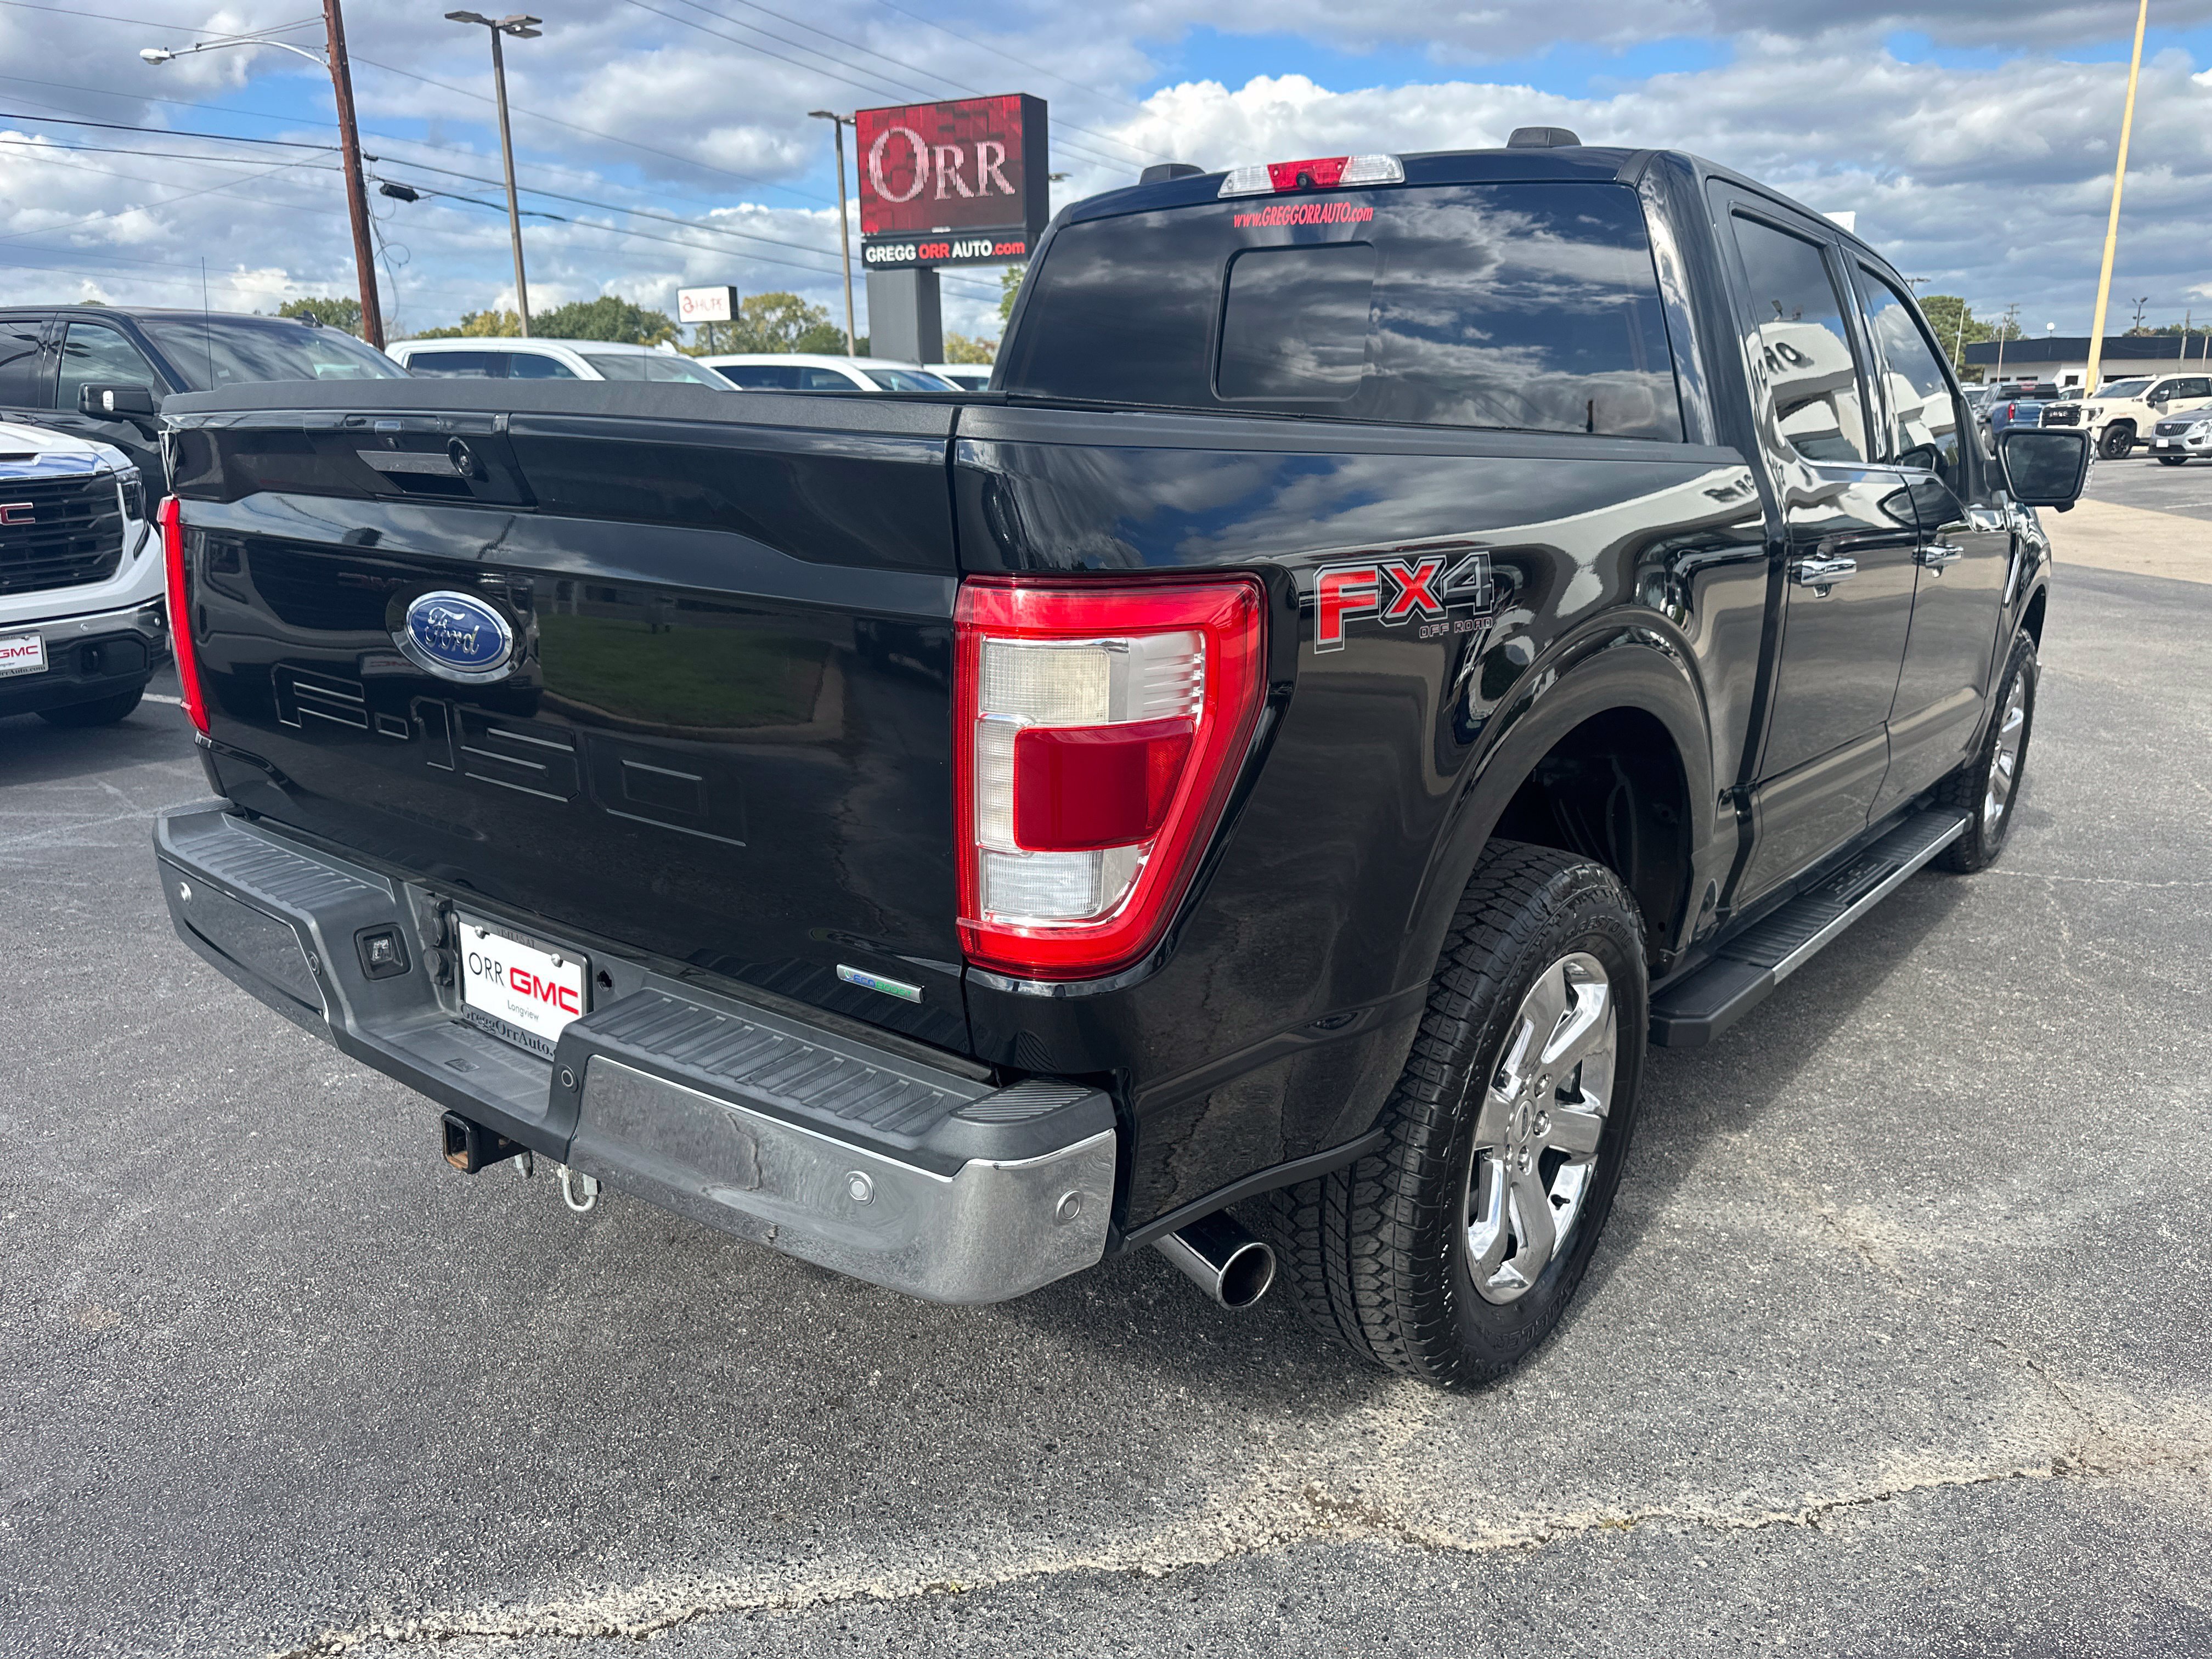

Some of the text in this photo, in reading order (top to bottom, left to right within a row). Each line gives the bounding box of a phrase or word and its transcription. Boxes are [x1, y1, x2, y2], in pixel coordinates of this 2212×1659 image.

[867, 126, 1016, 203] ORR
[1234, 202, 1374, 228] www.GREGGORRAUTO.com
[866, 240, 1025, 262] GREGG ORR AUTO.com
[1313, 551, 1495, 654] FX4
[0, 645, 38, 659] GMC
[424, 607, 481, 656] Ford
[1419, 617, 1493, 639] OFF ROAD
[270, 662, 747, 848] F-150
[469, 952, 579, 1015] ORR GMC
[460, 1004, 556, 1057] GreggOrrAuto.
[507, 999, 539, 1022] Longview
